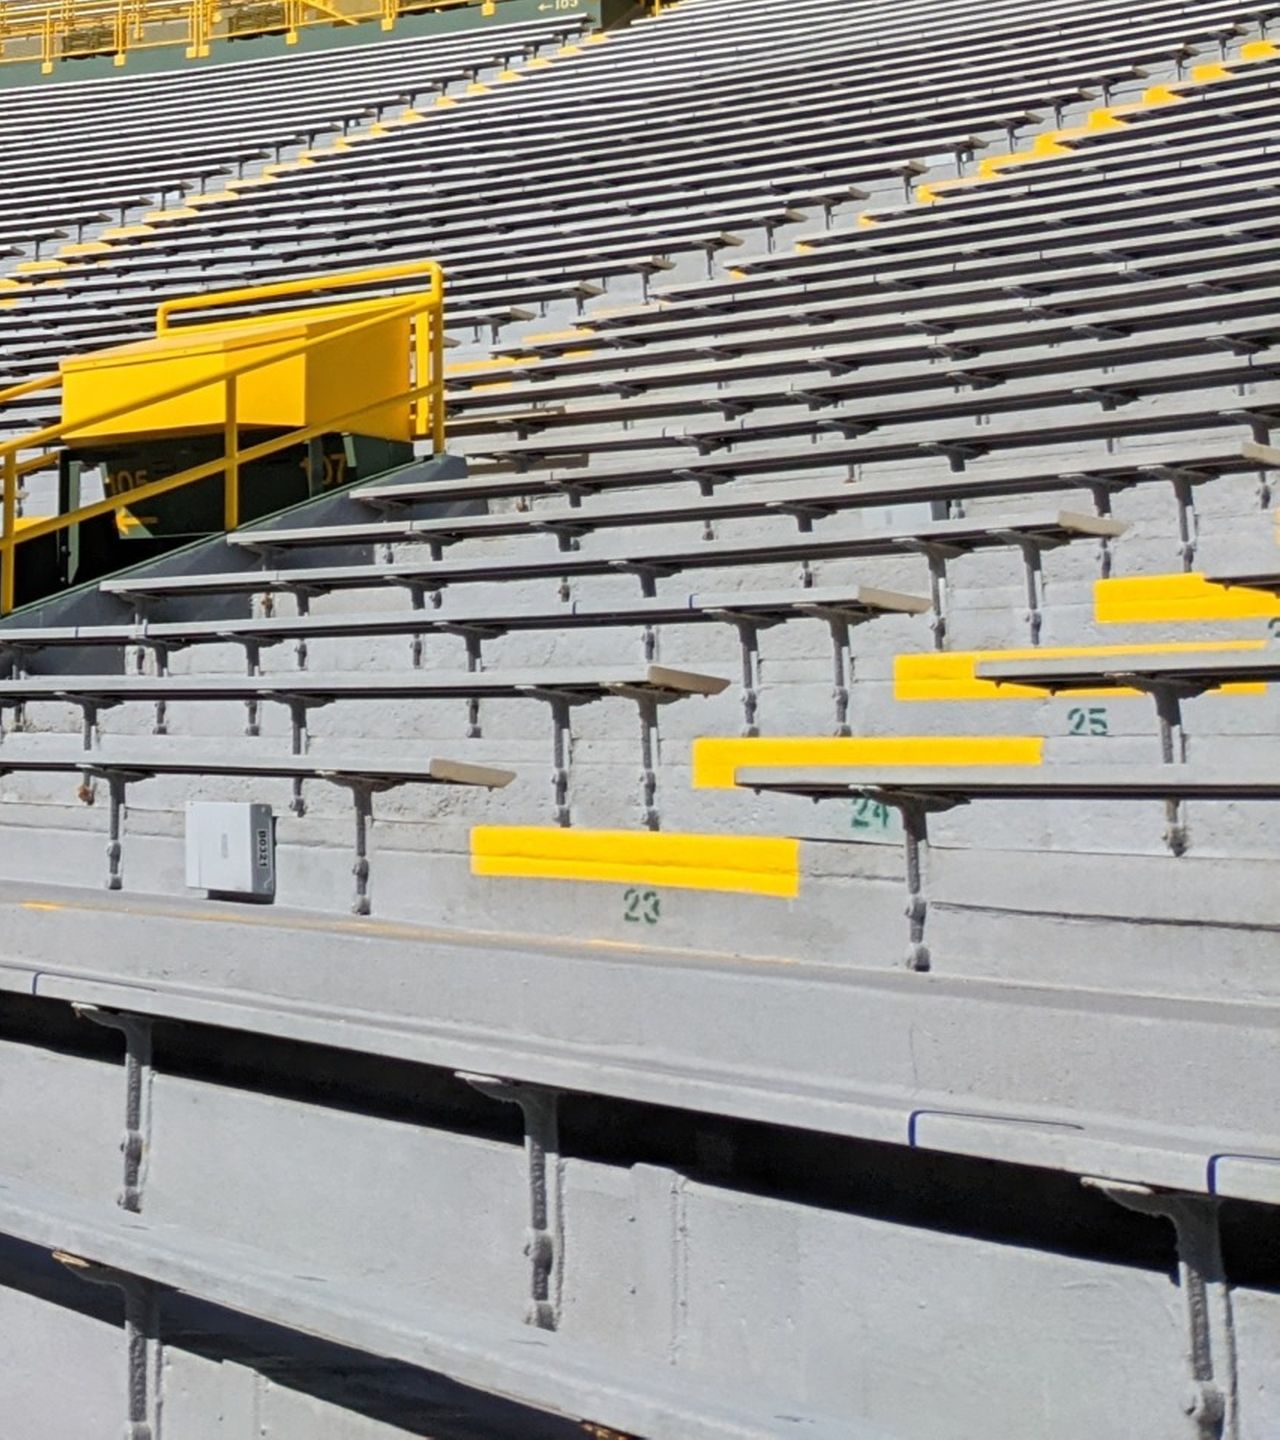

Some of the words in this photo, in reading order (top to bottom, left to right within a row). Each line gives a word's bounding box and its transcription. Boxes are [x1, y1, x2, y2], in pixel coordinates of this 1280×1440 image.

[1067, 707, 1108, 736] 25
[851, 796, 888, 827] 24
[623, 887, 661, 924] 23
